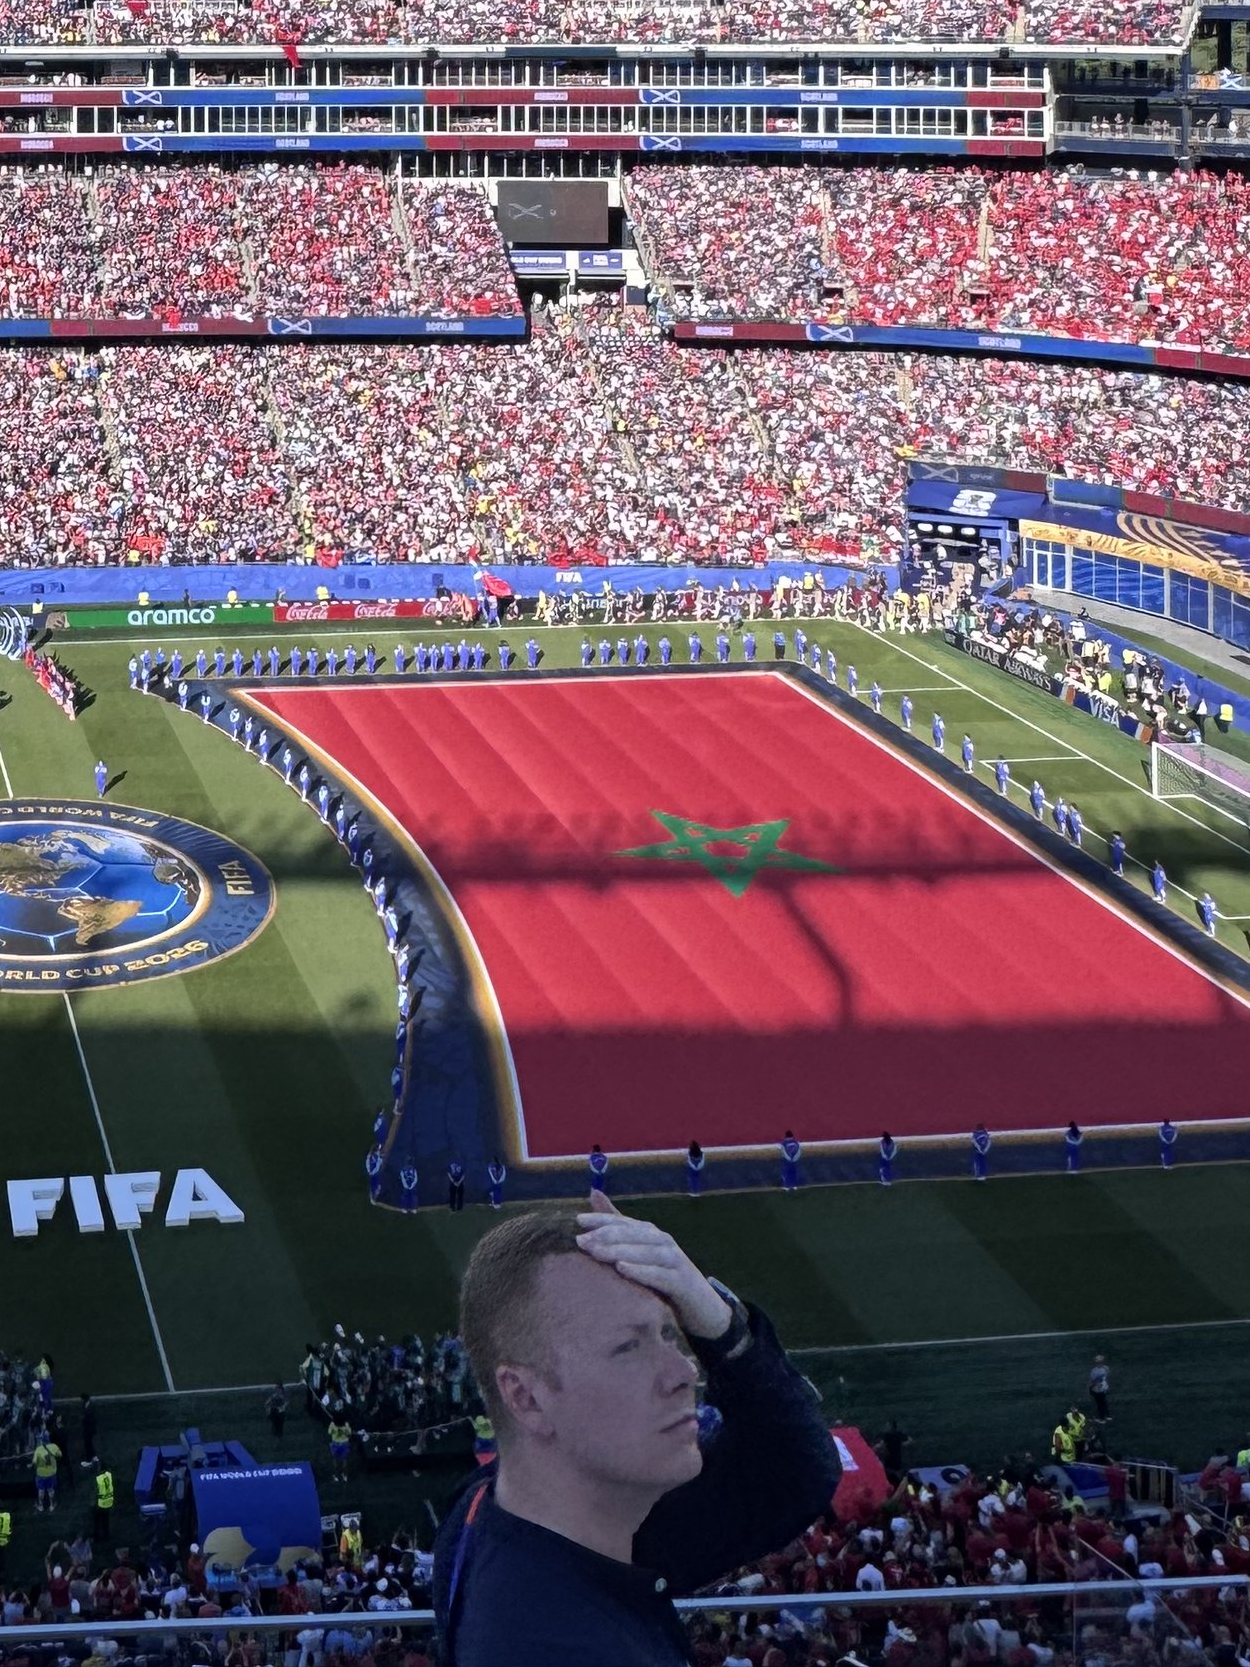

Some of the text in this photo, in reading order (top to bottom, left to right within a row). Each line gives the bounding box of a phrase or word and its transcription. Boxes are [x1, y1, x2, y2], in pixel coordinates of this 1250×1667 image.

[128, 608, 215, 626] aramco
[65, 964, 120, 979] CUP
[124, 940, 209, 971] 2026
[6, 1167, 246, 1237] FIFA
